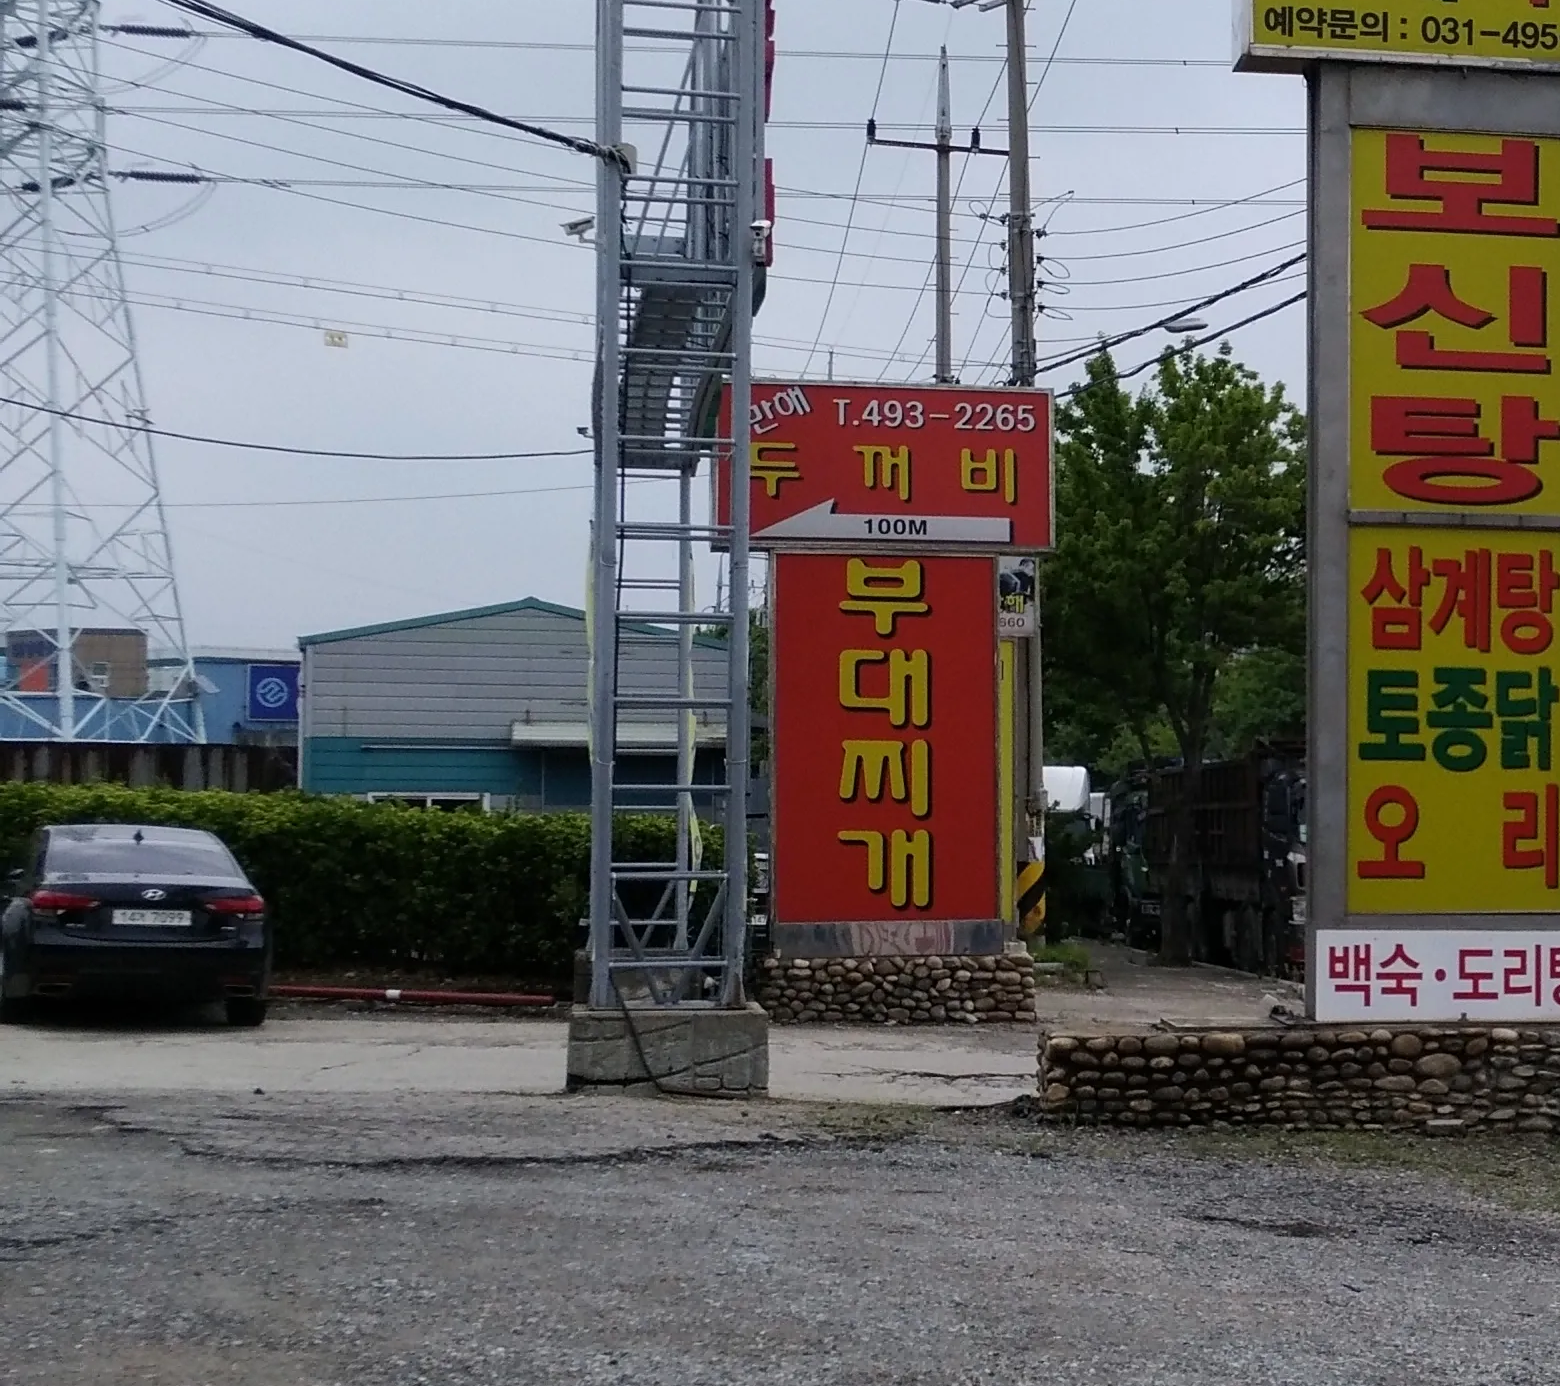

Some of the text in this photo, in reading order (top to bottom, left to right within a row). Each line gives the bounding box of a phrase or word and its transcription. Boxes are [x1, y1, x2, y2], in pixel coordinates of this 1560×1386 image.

[832, 398, 1037, 432] T.493-2265
[863, 518, 928, 536] 100M
[1361, 545, 1560, 655] 삼계탕
[838, 557, 931, 909] 부대찌개
[1358, 666, 1560, 773] 토종닭
